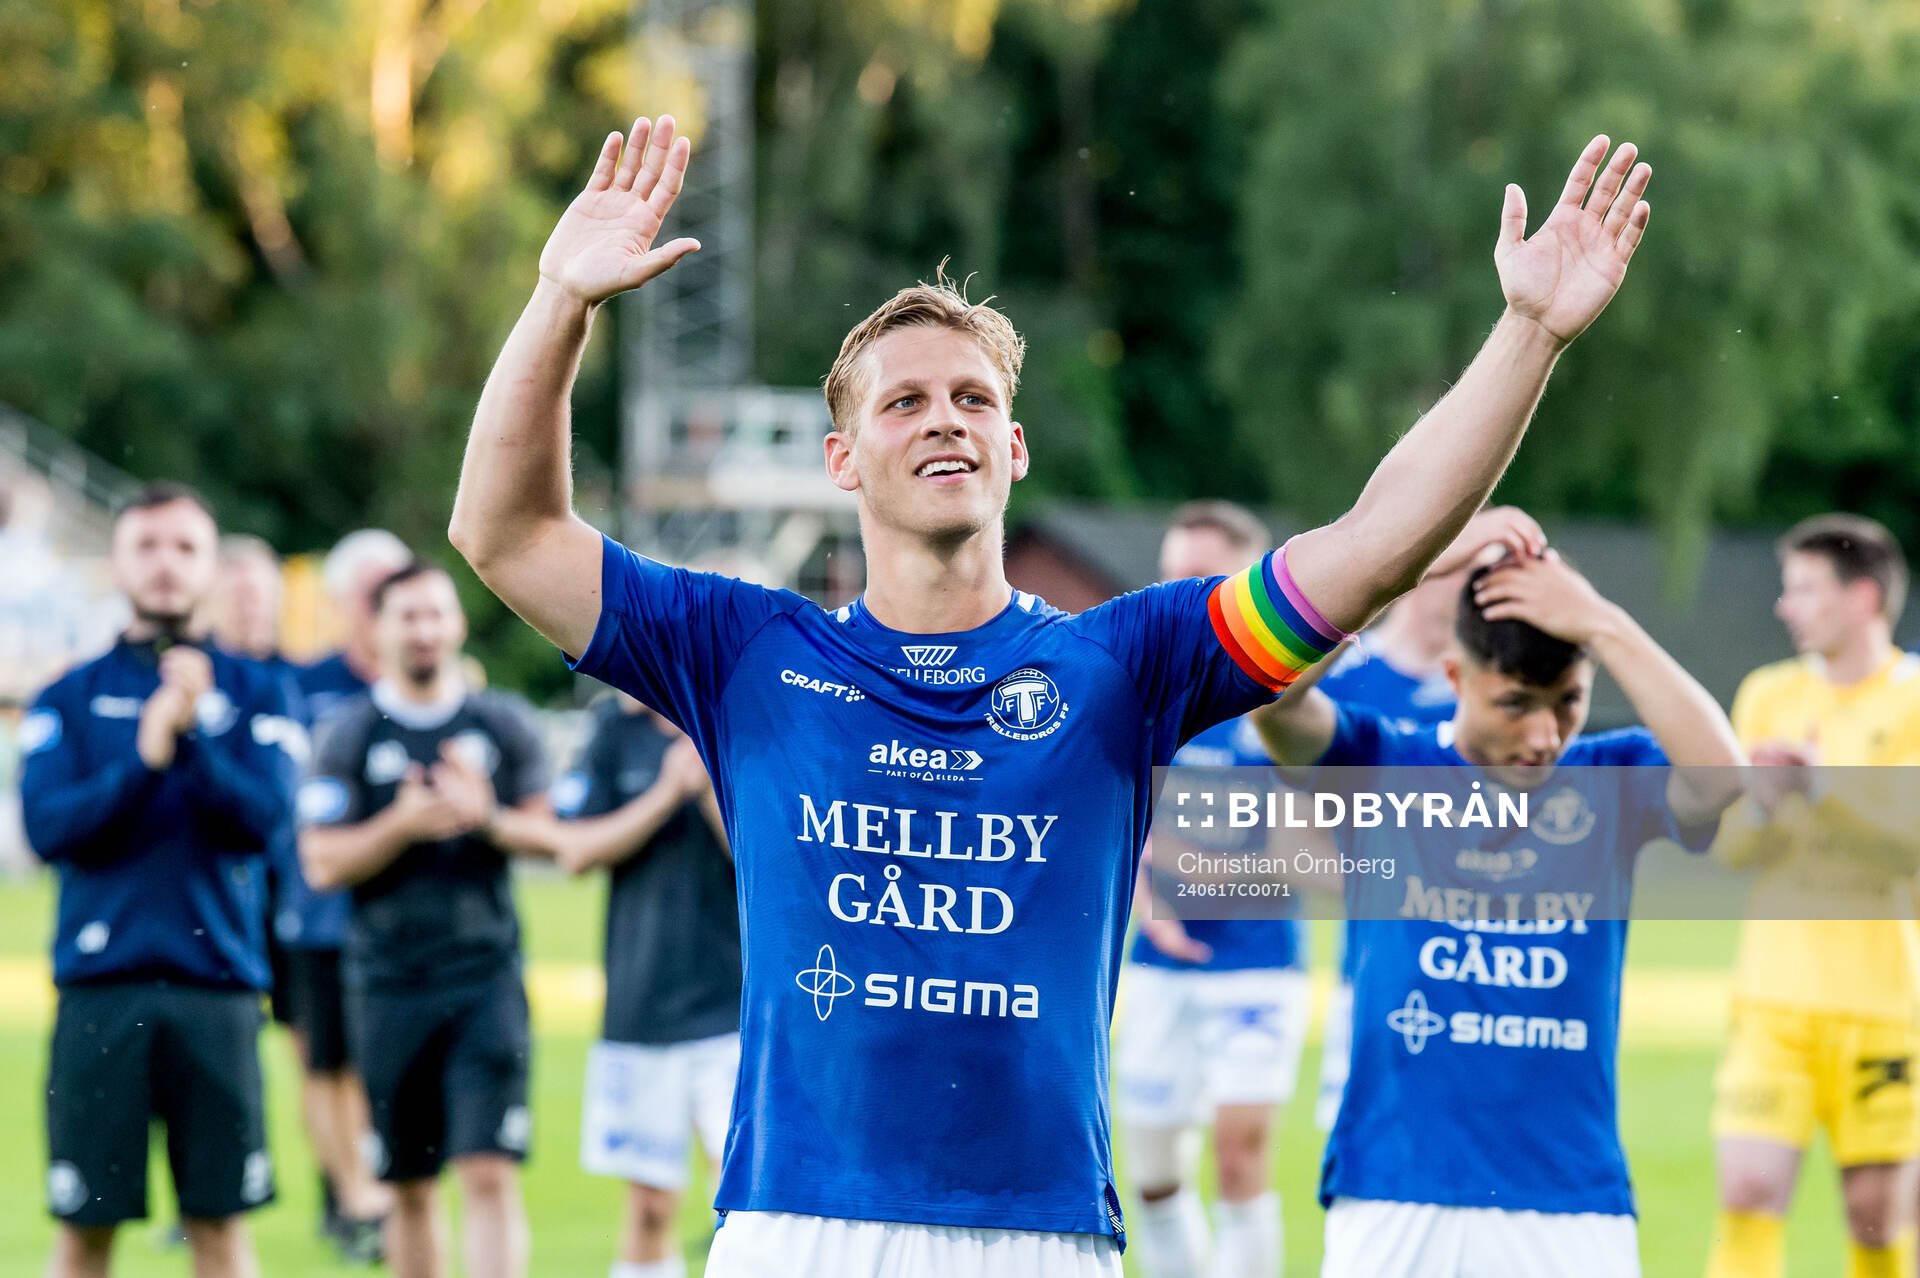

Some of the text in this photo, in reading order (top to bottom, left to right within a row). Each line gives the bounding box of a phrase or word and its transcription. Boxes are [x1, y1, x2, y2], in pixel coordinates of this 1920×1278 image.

[780, 669, 849, 697] CRAFT
[869, 739, 947, 770] akea
[886, 769, 965, 782] PART OF ELEDA
[797, 794, 1058, 862] MELLBY
[828, 864, 1014, 934] GÅRD
[1399, 875, 1595, 935] MELLBY
[1419, 933, 1568, 989] GÅRD
